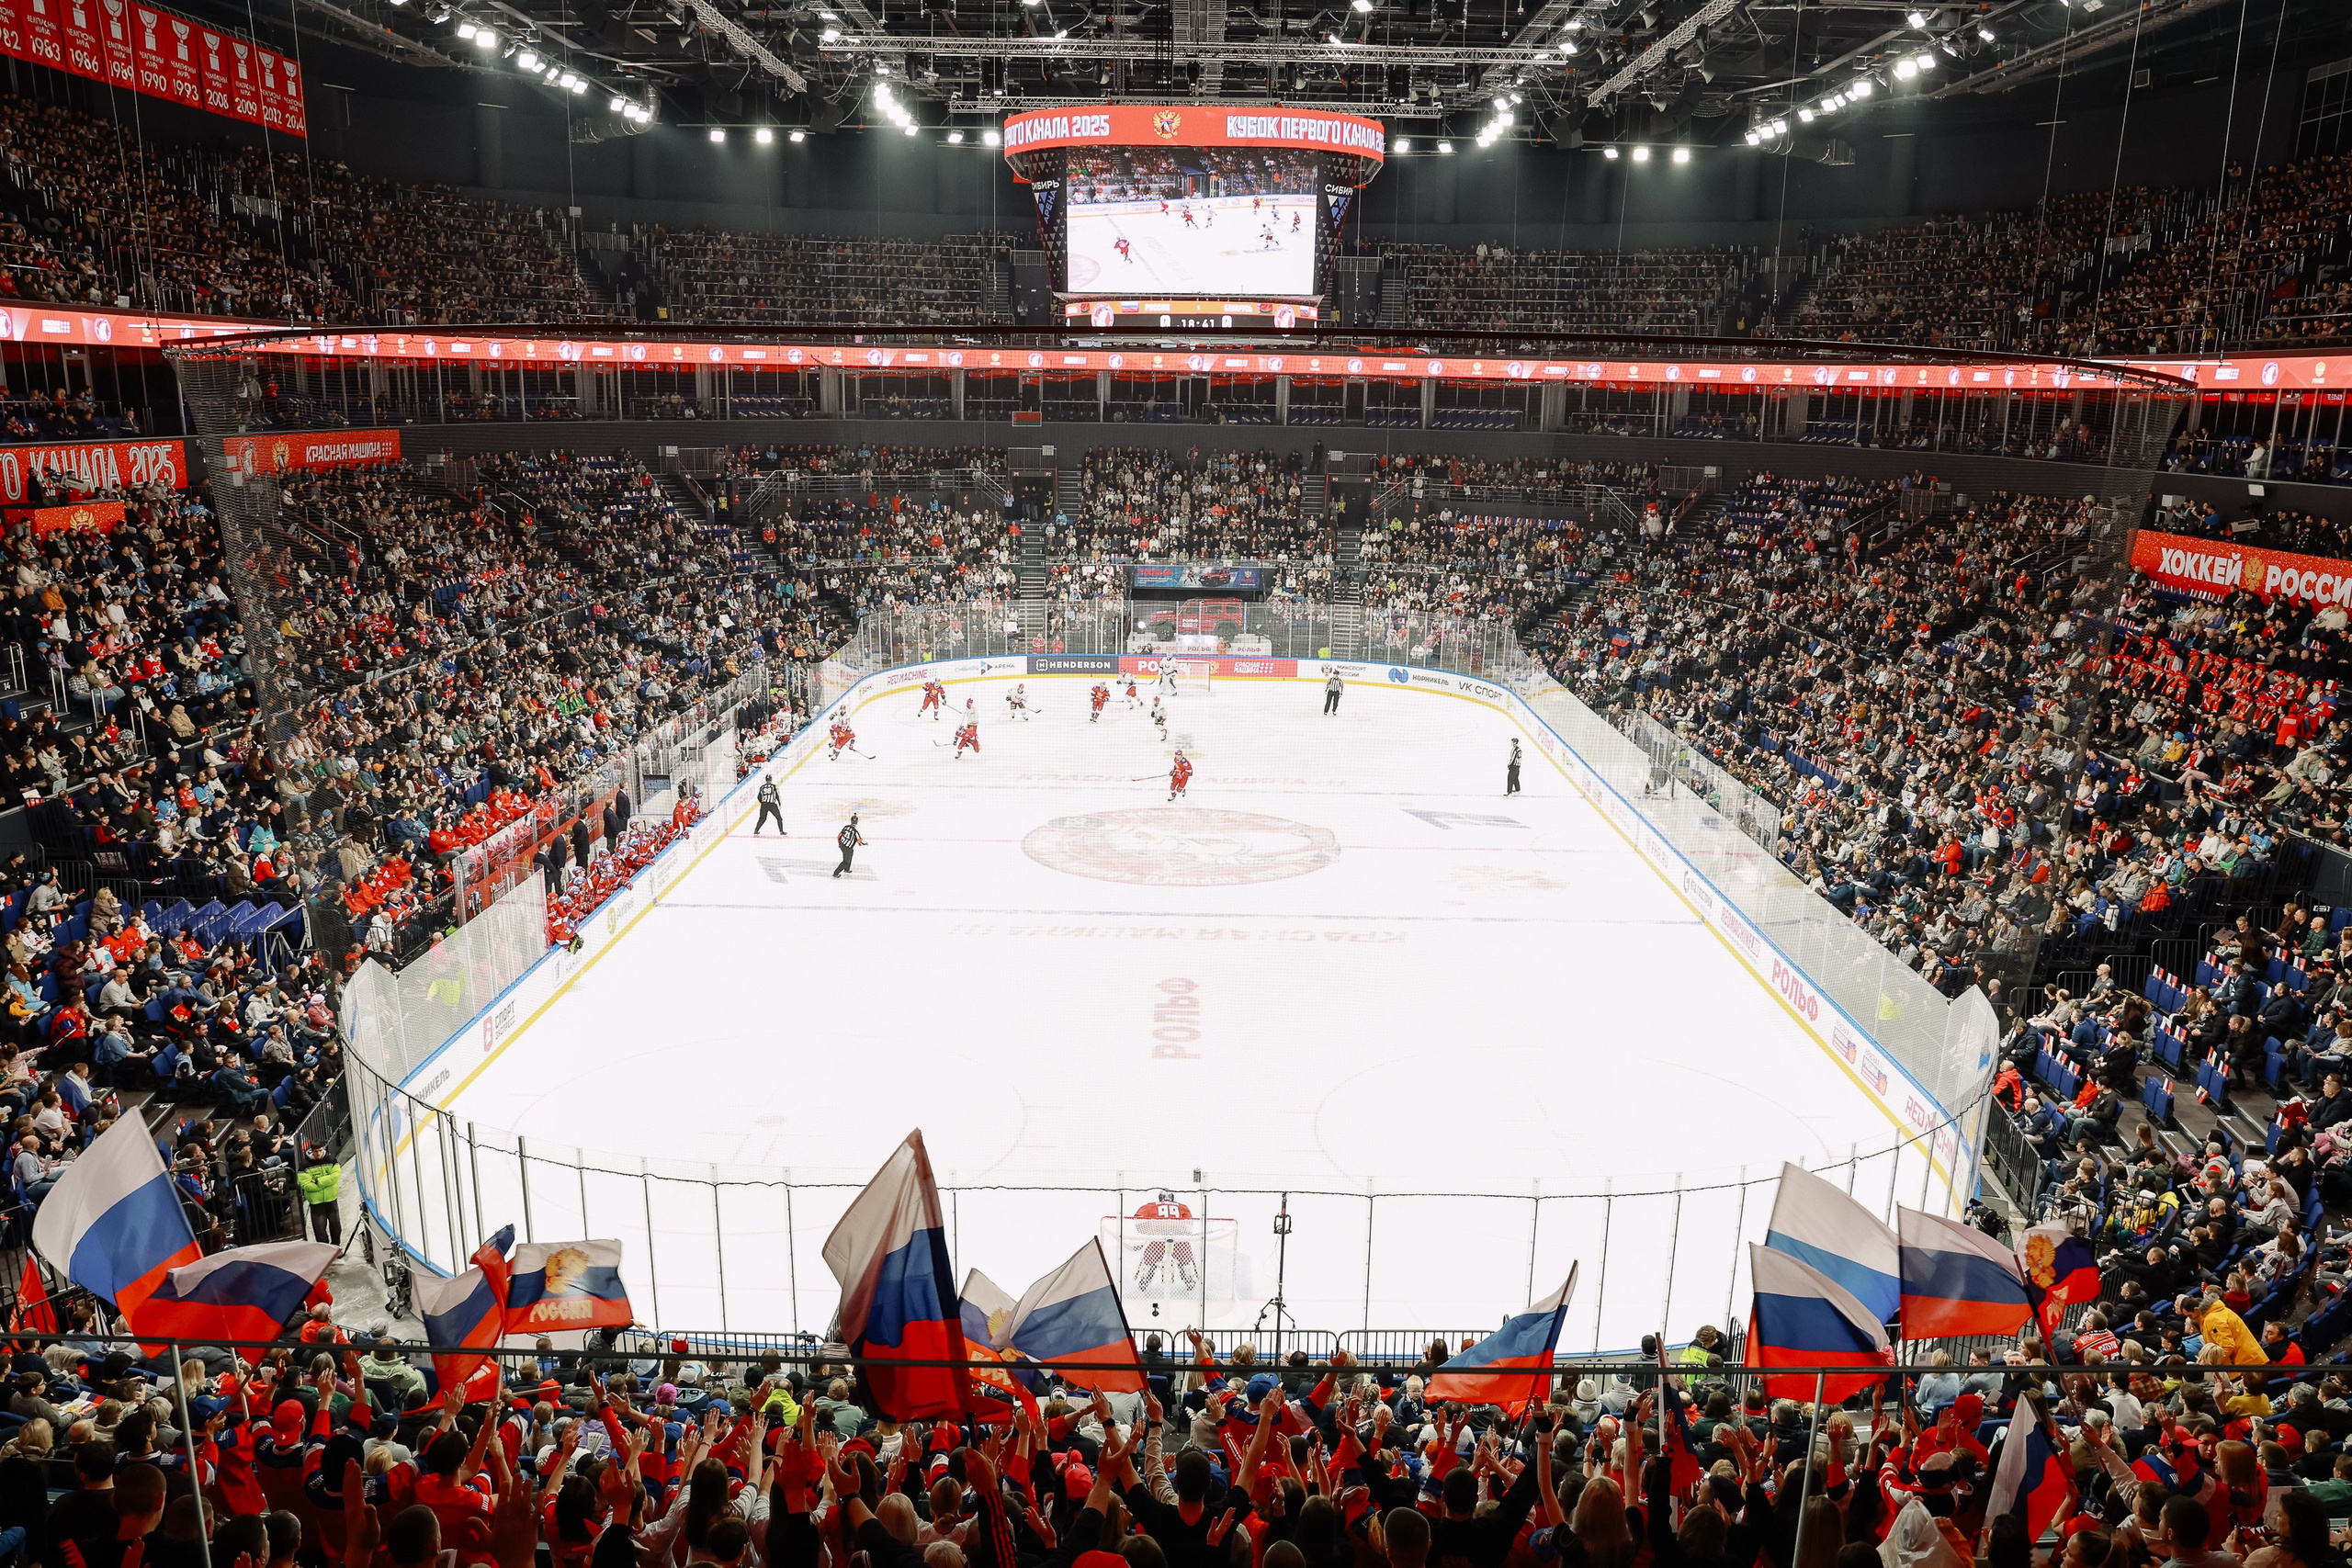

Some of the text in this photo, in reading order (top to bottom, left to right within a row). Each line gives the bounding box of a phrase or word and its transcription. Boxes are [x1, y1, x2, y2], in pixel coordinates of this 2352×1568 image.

[30, 35, 61, 62] 1983
[70, 48, 99, 73] 1986
[109, 60, 134, 82] 1989
[140, 69, 167, 92] 1990
[173, 79, 199, 101] 1993
[206, 89, 230, 109] 2008
[234, 97, 257, 117] 2009
[263, 106, 283, 125] 2012
[285, 114, 305, 131] 2014
[1025, 116, 1070, 144] КАНАЛА
[1071, 115, 1110, 137] 2025
[1227, 116, 1280, 139] КУБОК
[1281, 117, 1340, 144] ПЕРВОГО
[1342, 121, 1376, 149] КАНАЛА
[1044, 190, 1057, 225] АРЕНА
[306, 441, 381, 463] КРАСНАЯ МАШИНА
[130, 445, 176, 489] 2025
[2157, 547, 2243, 586] ХОККЕЙ
[1049, 661, 1111, 670] HENDERSON
[4, 682, 10, 691] 14
[1412, 674, 1449, 686] НОРНИКЕЛЬ
[1475, 685, 1502, 701] СПОРТ
[20, 711, 28, 719] 13
[85, 726, 92, 735] 12
[1771, 957, 1819, 1021] РОЛЬФ
[1151, 976, 1203, 1059] РОЛЬФ
